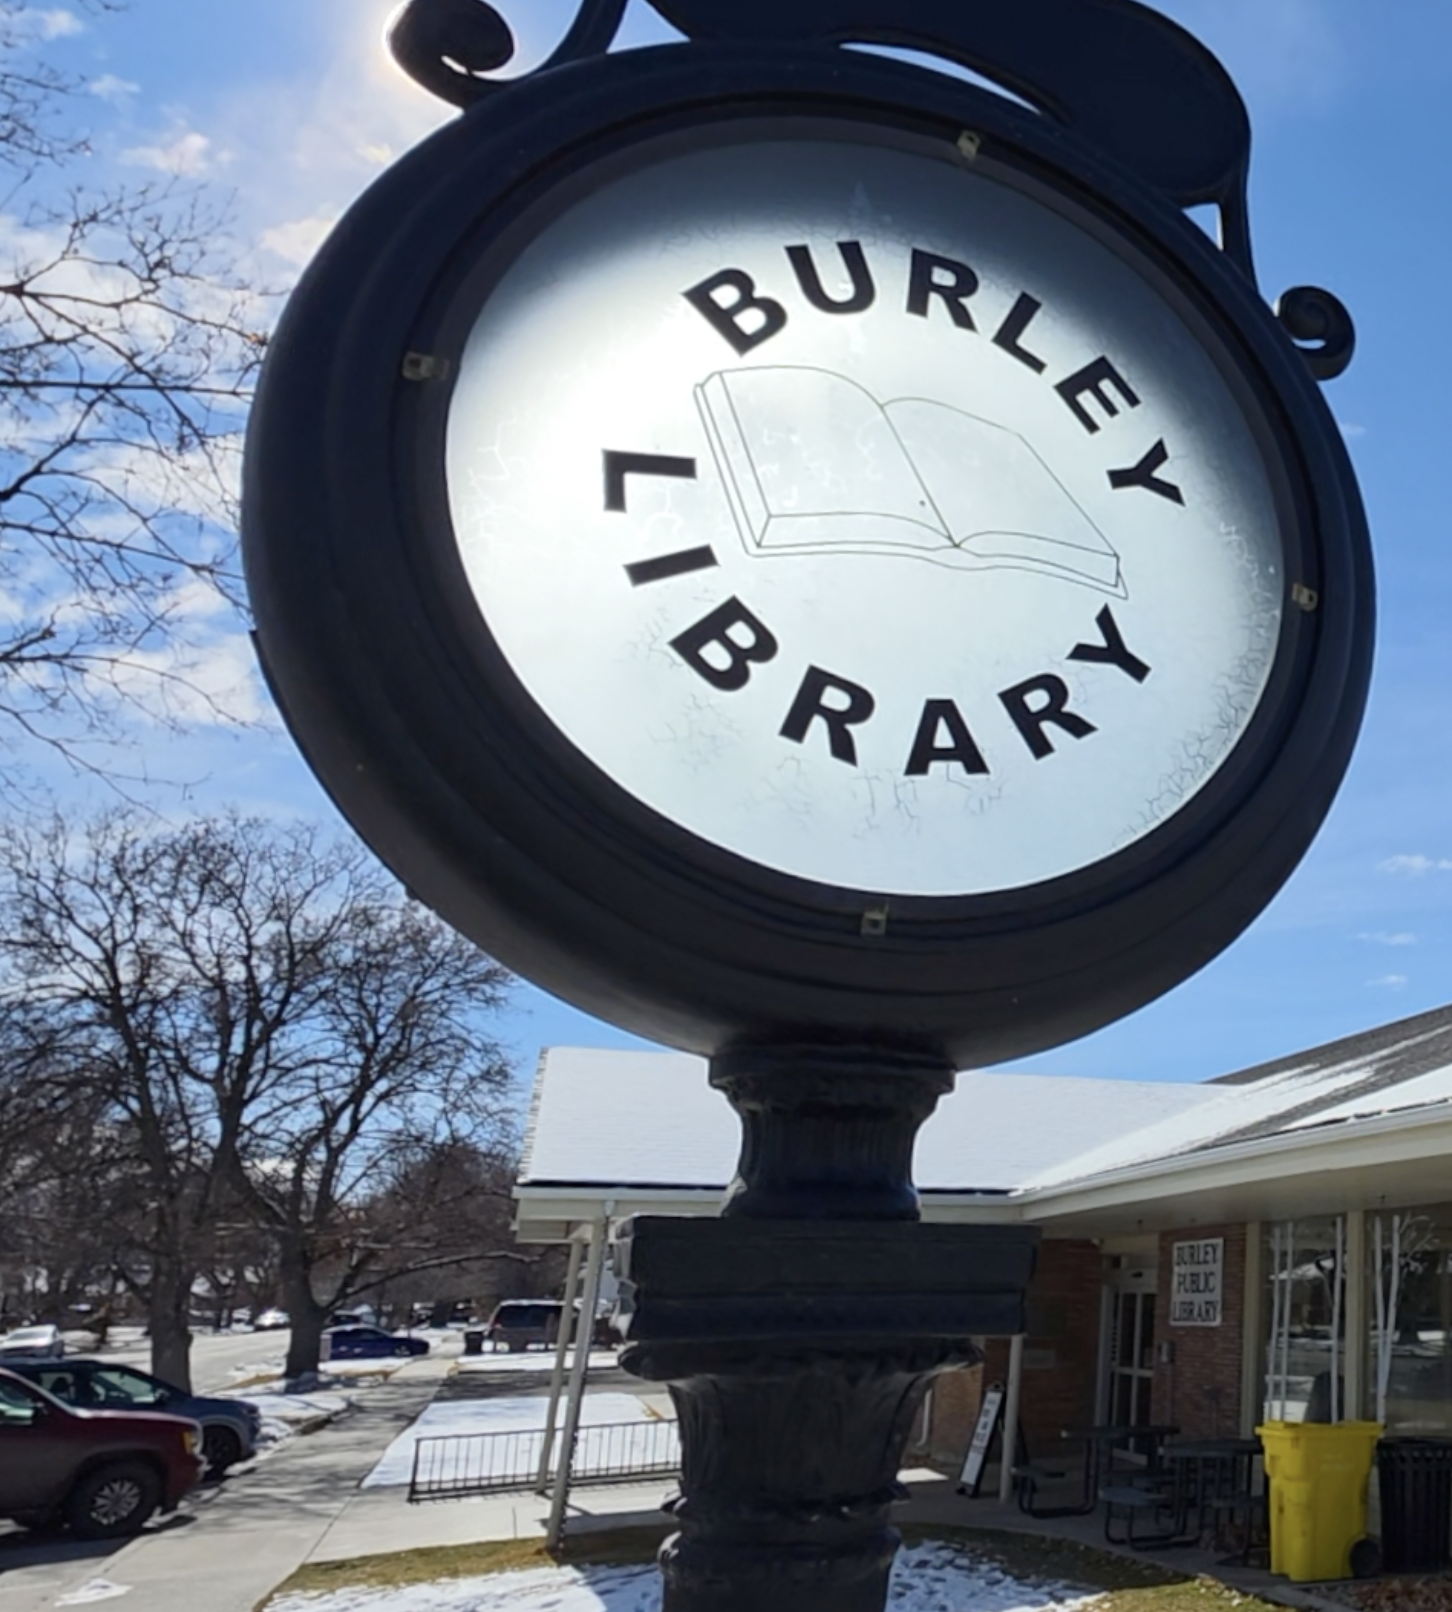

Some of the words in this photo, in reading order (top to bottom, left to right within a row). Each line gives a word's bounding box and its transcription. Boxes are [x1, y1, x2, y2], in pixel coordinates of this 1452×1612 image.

[682, 241, 1185, 507] BURLEY
[602, 449, 1151, 776] LIBRARY
[1176, 1243, 1219, 1266] BURLEY
[1176, 1271, 1216, 1294] PUBLIC
[1172, 1300, 1219, 1322] LIBRARY
